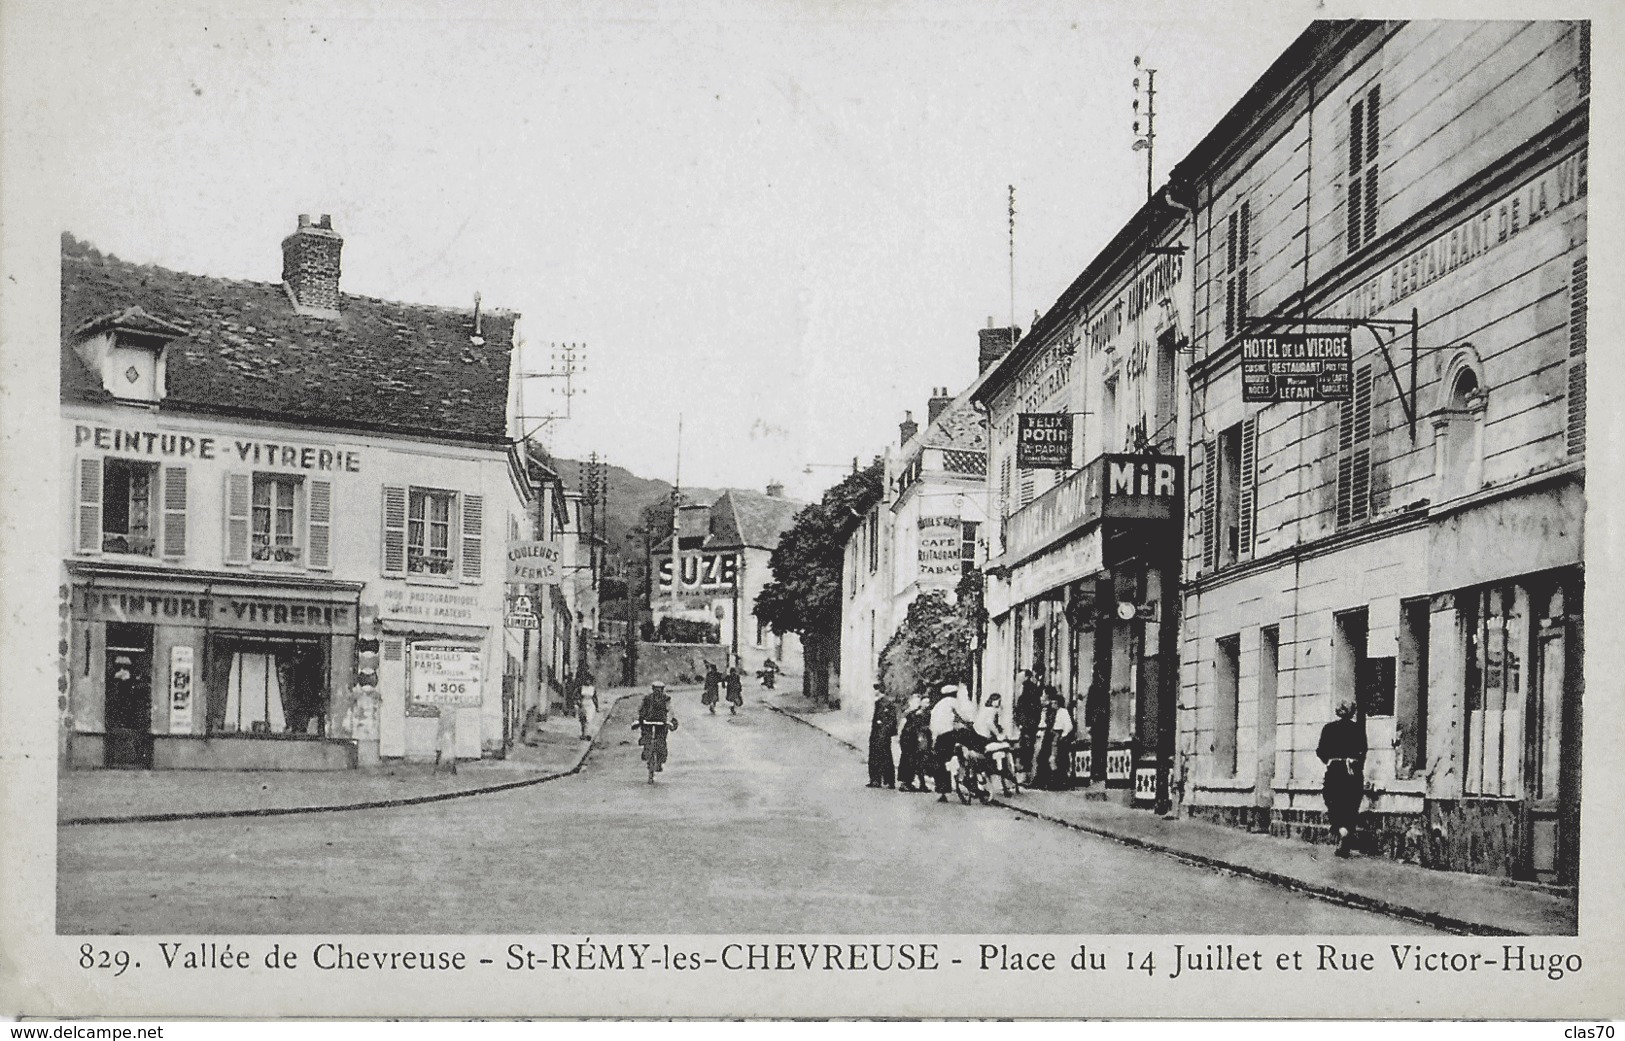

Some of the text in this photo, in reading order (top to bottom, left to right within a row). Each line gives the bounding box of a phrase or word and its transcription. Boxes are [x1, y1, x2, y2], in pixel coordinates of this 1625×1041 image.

[1243, 337, 1348, 358] HOTEL DE LA VIERGE
[1271, 362, 1321, 373] RESTAURANT
[1279, 387, 1315, 399] LEFANT
[1028, 417, 1063, 428] FELIX
[1023, 428, 1068, 441] POTIN
[75, 424, 215, 460] PEINTURE
[234, 440, 361, 473] VITRERIE
[508, 545, 560, 563] COULEURS
[514, 564, 555, 579] VERNIS
[231, 600, 350, 626] VITRERIE
[415, 652, 461, 662] VERSAILLES
[414, 660, 442, 671] PARIS
[427, 682, 466, 693] N 306
